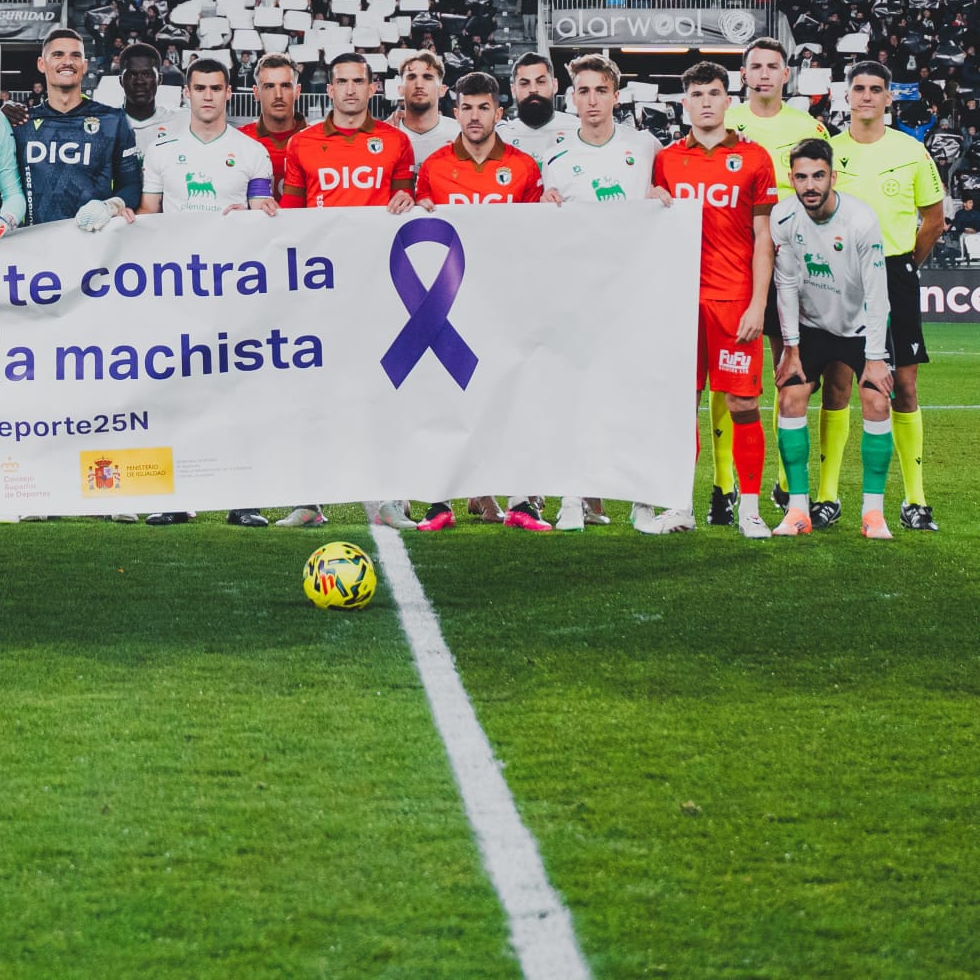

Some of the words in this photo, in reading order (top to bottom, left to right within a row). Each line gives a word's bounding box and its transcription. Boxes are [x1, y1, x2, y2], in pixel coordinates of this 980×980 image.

[25, 140, 92, 166] DIGI
[317, 165, 384, 191] DIGI
[674, 182, 740, 209] DIGI
[80, 252, 270, 300] contra
[286, 247, 336, 292] la
[55, 326, 324, 381] machista
